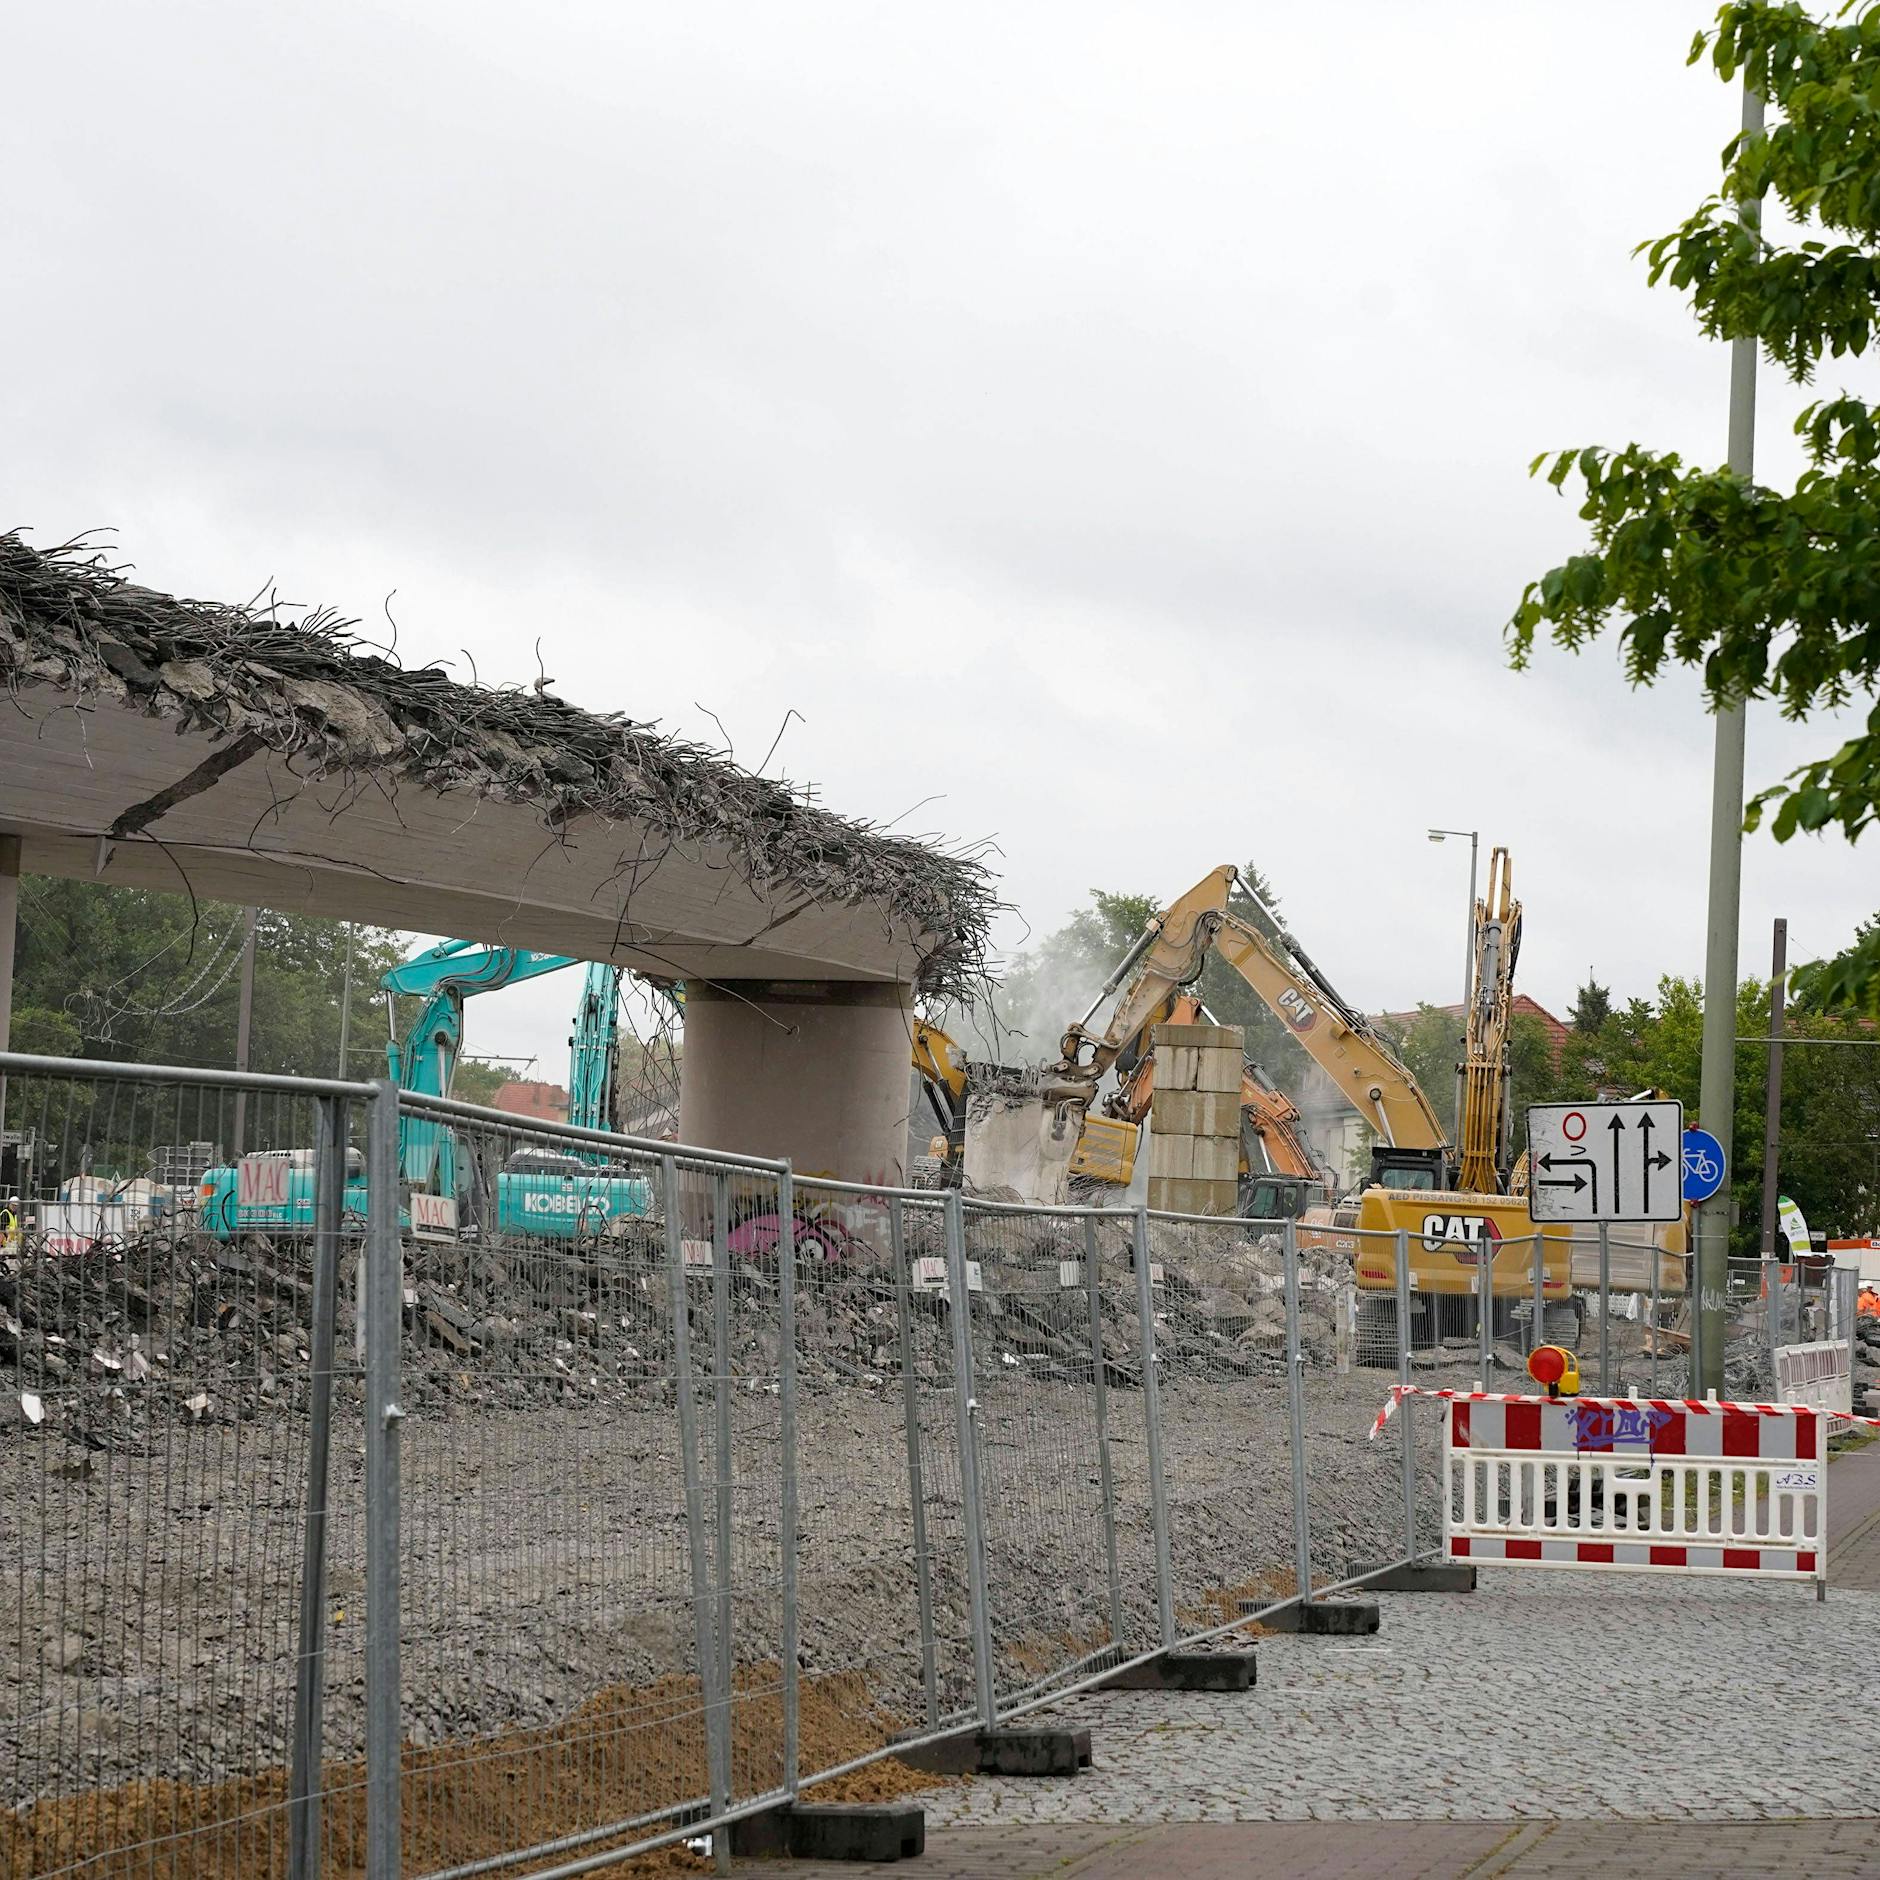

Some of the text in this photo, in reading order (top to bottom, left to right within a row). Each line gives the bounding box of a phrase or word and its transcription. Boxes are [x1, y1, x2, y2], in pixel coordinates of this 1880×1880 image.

[1278, 988, 1314, 1023] CAT
[241, 1162, 289, 1203] MAC
[417, 1198, 448, 1226] MAC
[1424, 1214, 1484, 1253] CAT
